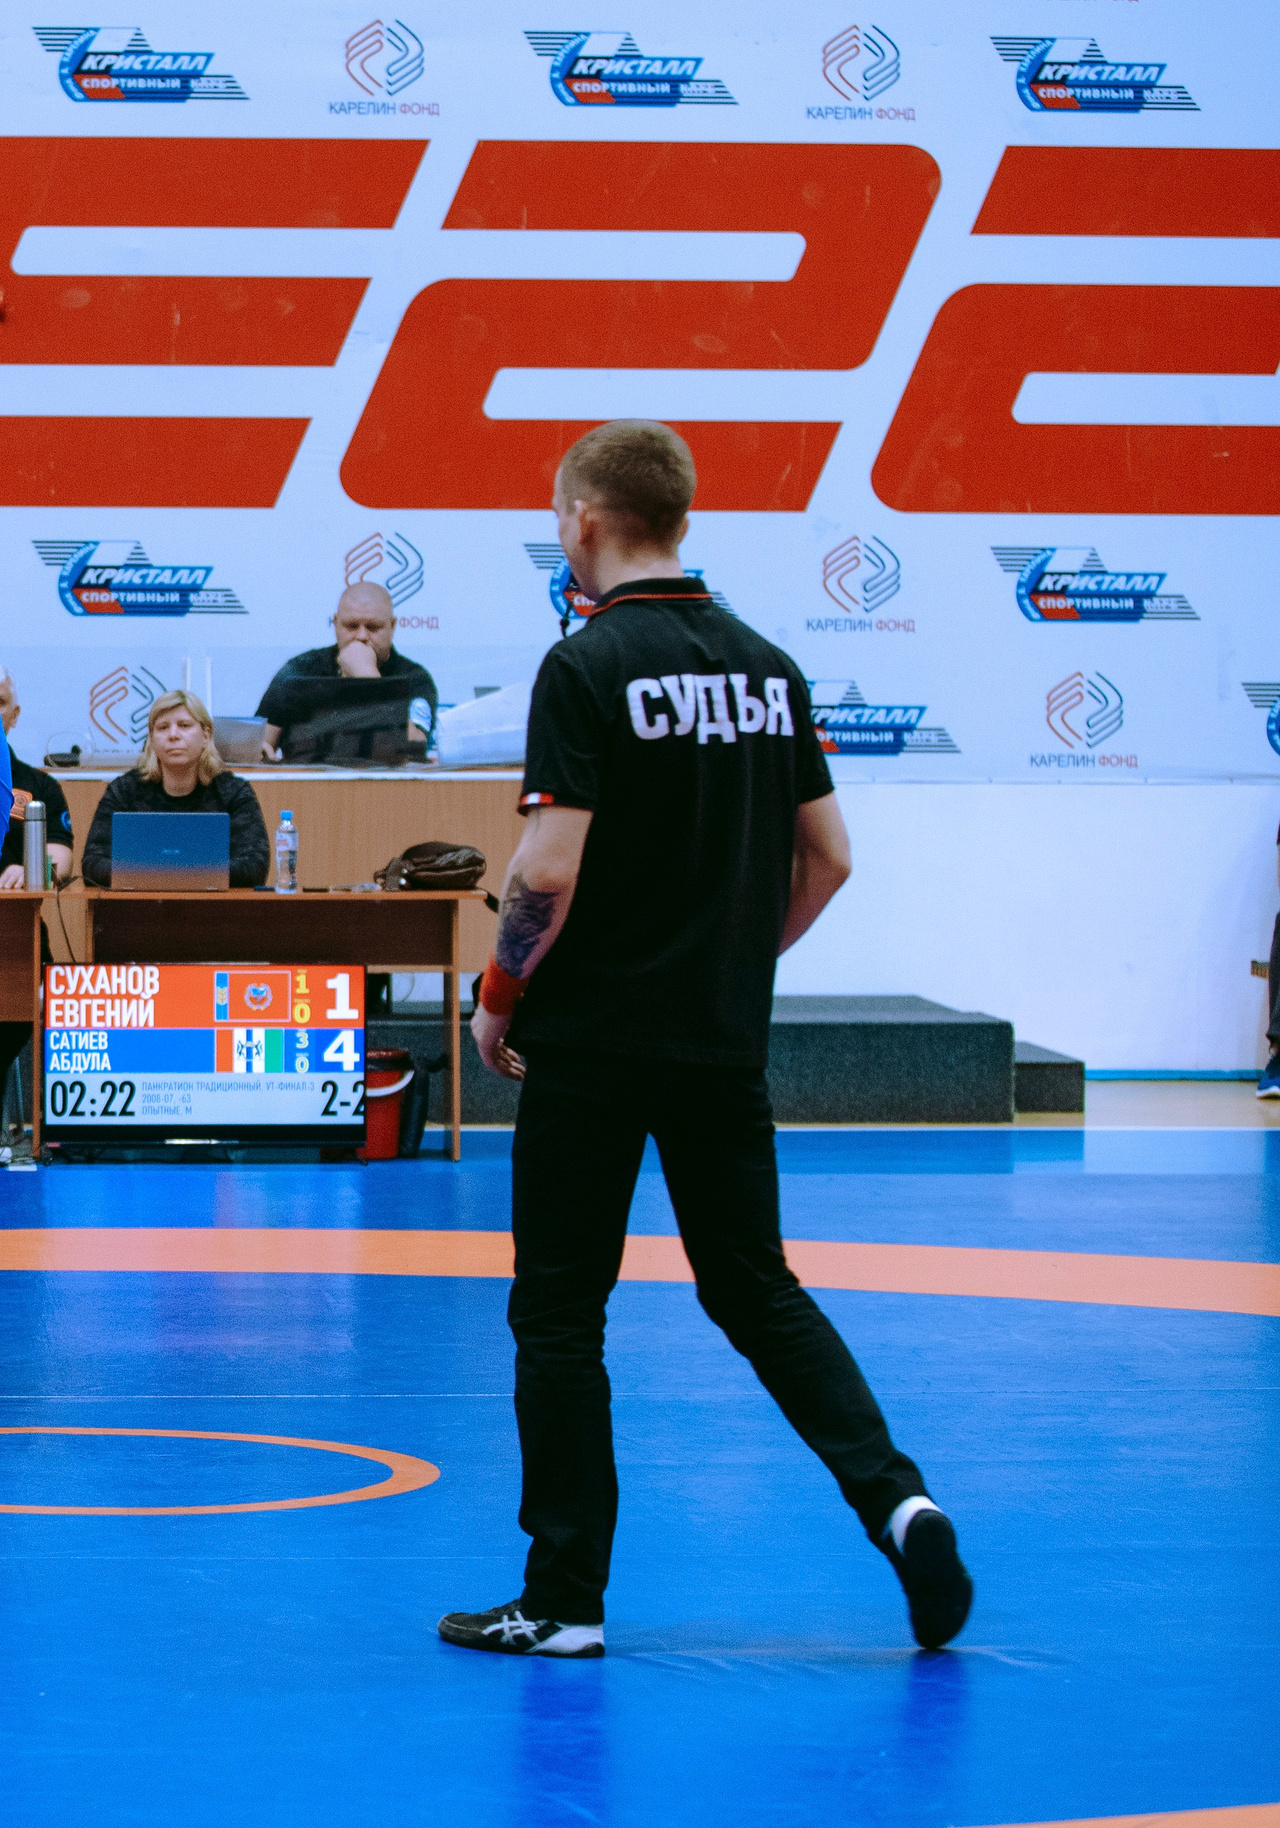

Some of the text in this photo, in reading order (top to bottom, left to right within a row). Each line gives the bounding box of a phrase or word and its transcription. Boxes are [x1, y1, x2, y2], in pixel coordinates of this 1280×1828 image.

[82, 54, 208, 71] КРИСТАЛЛ
[572, 59, 698, 76] КРИСТАЛЛ
[1037, 64, 1163, 81] КРИСТАЛЛ
[82, 78, 180, 90] СПОРТИВНЫЙ
[572, 83, 670, 95] СПОРТИВНЫЙ
[1037, 88, 1135, 100] СПОРТИВНЫЙ
[329, 102, 439, 117] КАРЕЛИН ФОНД
[806, 107, 915, 122] КАРЕЛИН ФОНД
[81, 568, 207, 585] КРИСТАЛЛ
[1037, 574, 1163, 591] КРИСТАЛЛ
[81, 592, 179, 604] СПОРТИВНЫЙ
[1037, 598, 1135, 610] СПОРТИВНЫЙ
[398, 616, 439, 629] ФОНД
[806, 619, 915, 634] КАРЕЛИН ФОНД
[626, 673, 795, 744] СУДЬЯ
[1030, 755, 1138, 770] КАРЕЛИН ФОНД
[49, 966, 160, 995] СУХАНОВ
[295, 974, 310, 994] 1
[325, 973, 359, 1019] 1
[49, 993, 155, 1027] ЕВГЕНИЙ
[293, 1003, 311, 1024] 0
[49, 1031, 108, 1050] САТИЕВ
[295, 1032, 309, 1049] 3
[322, 1030, 360, 1071] 4
[49, 1053, 112, 1074] АБДУЛА
[295, 1057, 309, 1073] 0
[142, 1082, 194, 1092] ПАНКРАТИОН
[51, 1080, 136, 1117] 02:22
